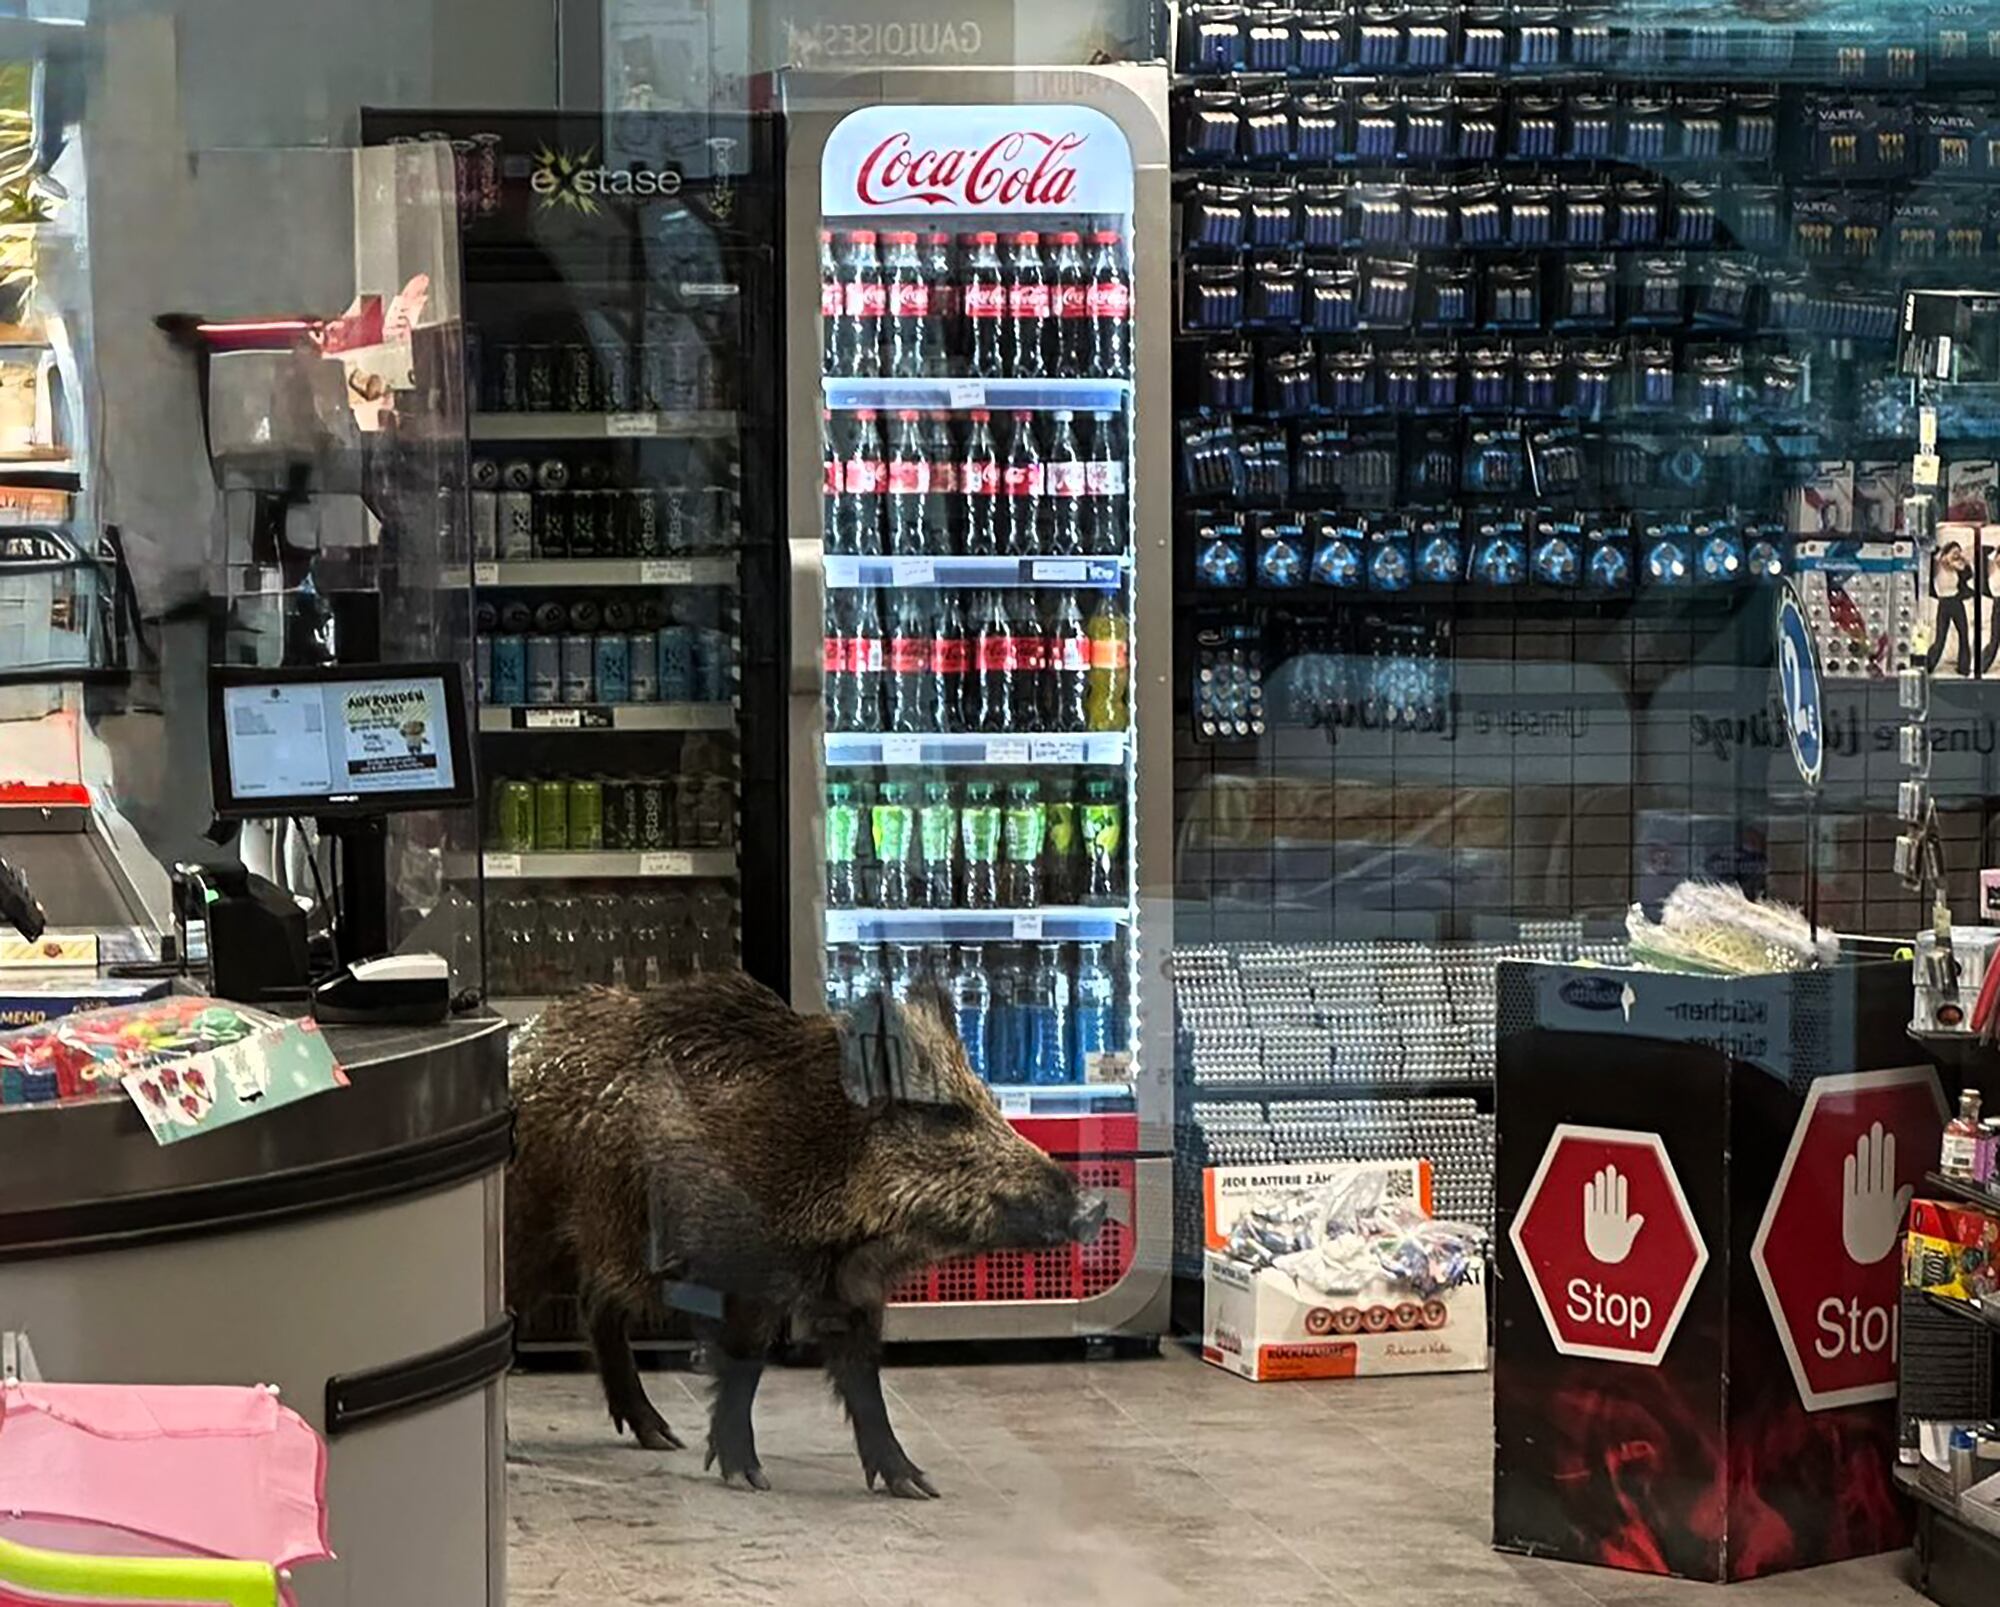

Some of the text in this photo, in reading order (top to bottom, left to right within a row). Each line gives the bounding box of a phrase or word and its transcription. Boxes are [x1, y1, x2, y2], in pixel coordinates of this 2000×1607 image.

[1819, 109, 1865, 120] VARTA
[1928, 116, 1975, 128] VARTA
[1793, 202, 1838, 213] VARTA
[1894, 206, 1940, 217] VARTA
[347, 689, 426, 709] AUFRUNDEN
[0, 1010, 47, 1025] MEMO
[1221, 1176, 1247, 1188] JEDE
[1250, 1174, 1302, 1187] BATTERIE
[1566, 1278, 1652, 1339] Stop
